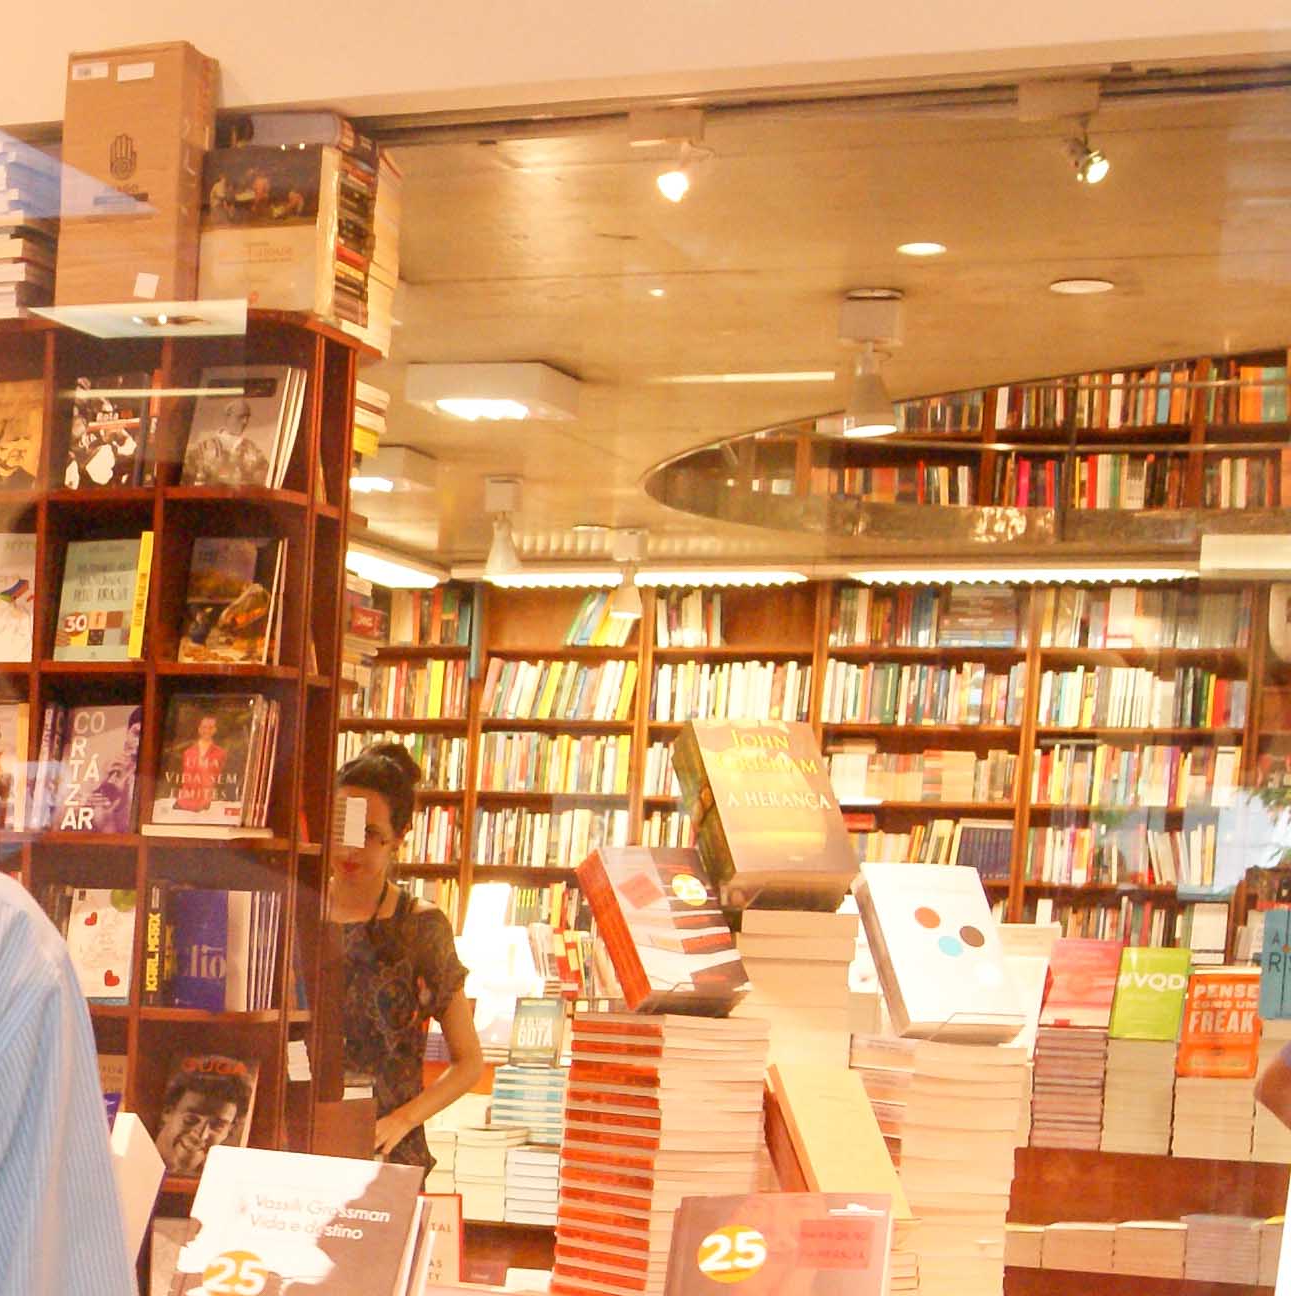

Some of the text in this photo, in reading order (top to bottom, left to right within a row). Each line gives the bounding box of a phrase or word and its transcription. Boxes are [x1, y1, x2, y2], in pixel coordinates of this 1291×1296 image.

[64, 614, 88, 633] 30
[73, 711, 106, 734] CO
[71, 736, 88, 758] R
[730, 728, 790, 751] JOHN
[69, 754, 101, 782] TÁ
[165, 772, 238, 787] VIDA SEM
[727, 790, 832, 812] A HERANÇA
[60, 806, 95, 831] AR
[1193, 983, 1261, 999] PENSE
[1188, 1010, 1254, 1035] FREAK
[304, 1221, 364, 1241] destino
[698, 1231, 767, 1273] 25
[204, 1257, 266, 1295] 25
